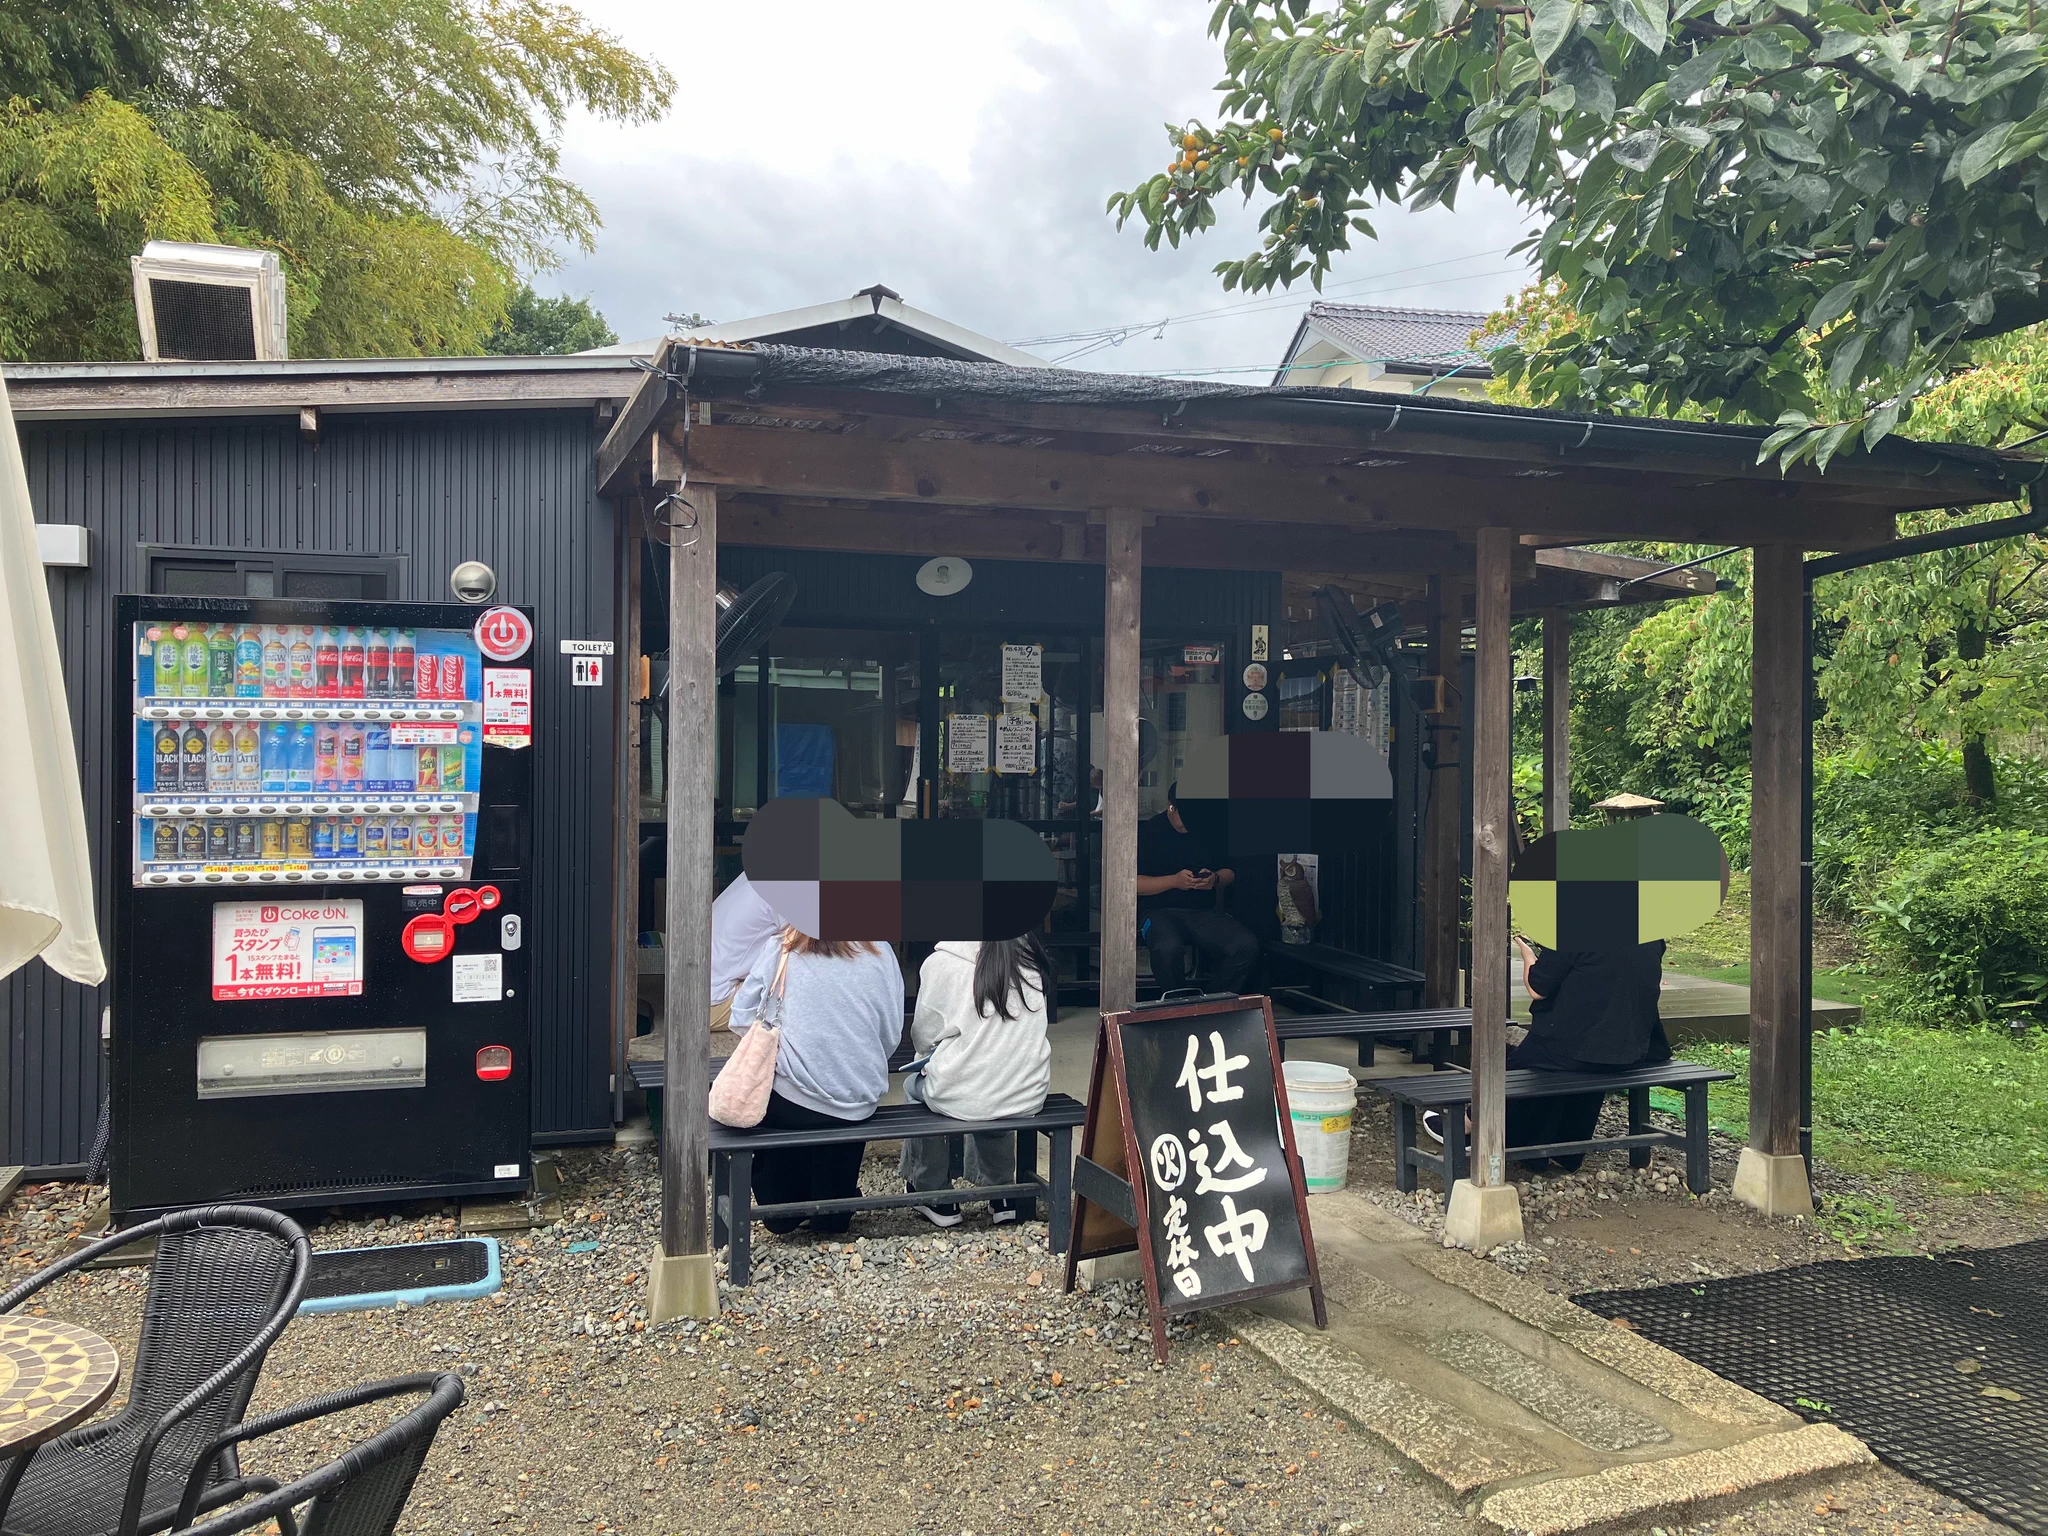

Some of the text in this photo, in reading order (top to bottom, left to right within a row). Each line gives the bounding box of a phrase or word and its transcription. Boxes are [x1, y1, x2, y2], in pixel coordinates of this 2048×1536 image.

[572, 643, 602, 652] TOILET
[419, 655, 432, 693] Coca-Cola
[443, 655, 456, 693] Coca-Cola
[486, 681, 528, 699] 1本無料!
[156, 754, 179, 763] BLACK
[184, 754, 206, 763] BLACK
[211, 755, 233, 763] LATTE
[237, 755, 259, 763] LATTE
[406, 898, 438, 908] 販売中
[280, 905, 346, 920] Coke ON
[234, 928, 269, 938] 買うたび
[232, 937, 283, 951] スタンプ
[225, 954, 301, 981] 1本無料!
[237, 985, 320, 997] 今すぐダウンロード!!
[1176, 1030, 1269, 1283] 仕込中
[1163, 1195, 1202, 1297] 定休日
